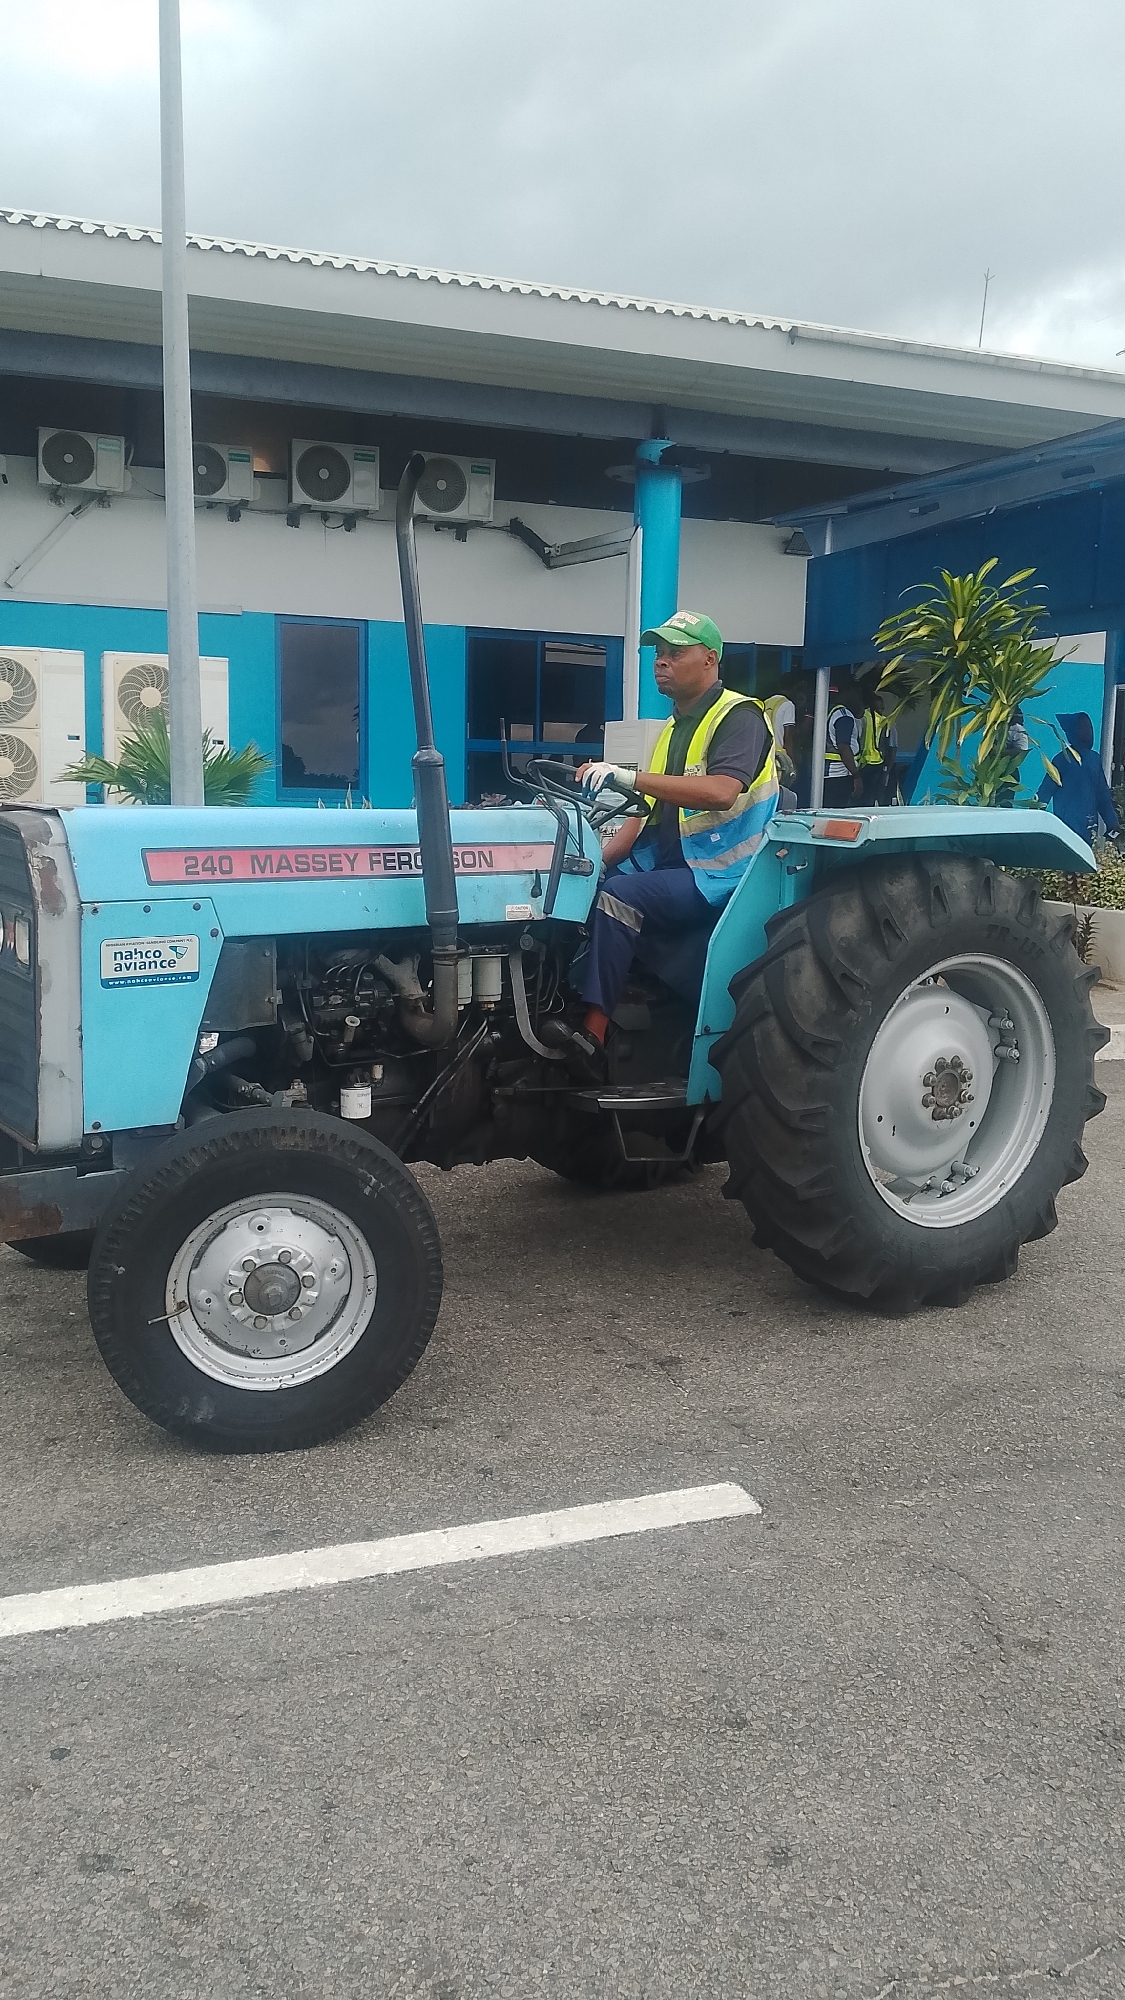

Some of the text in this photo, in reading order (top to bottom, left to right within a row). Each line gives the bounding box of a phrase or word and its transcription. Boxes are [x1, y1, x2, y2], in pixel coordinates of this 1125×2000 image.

[184, 850, 494, 876] 240 MASSEY FERON
[113, 948, 162, 961] nahco
[113, 958, 177, 972] aviance
